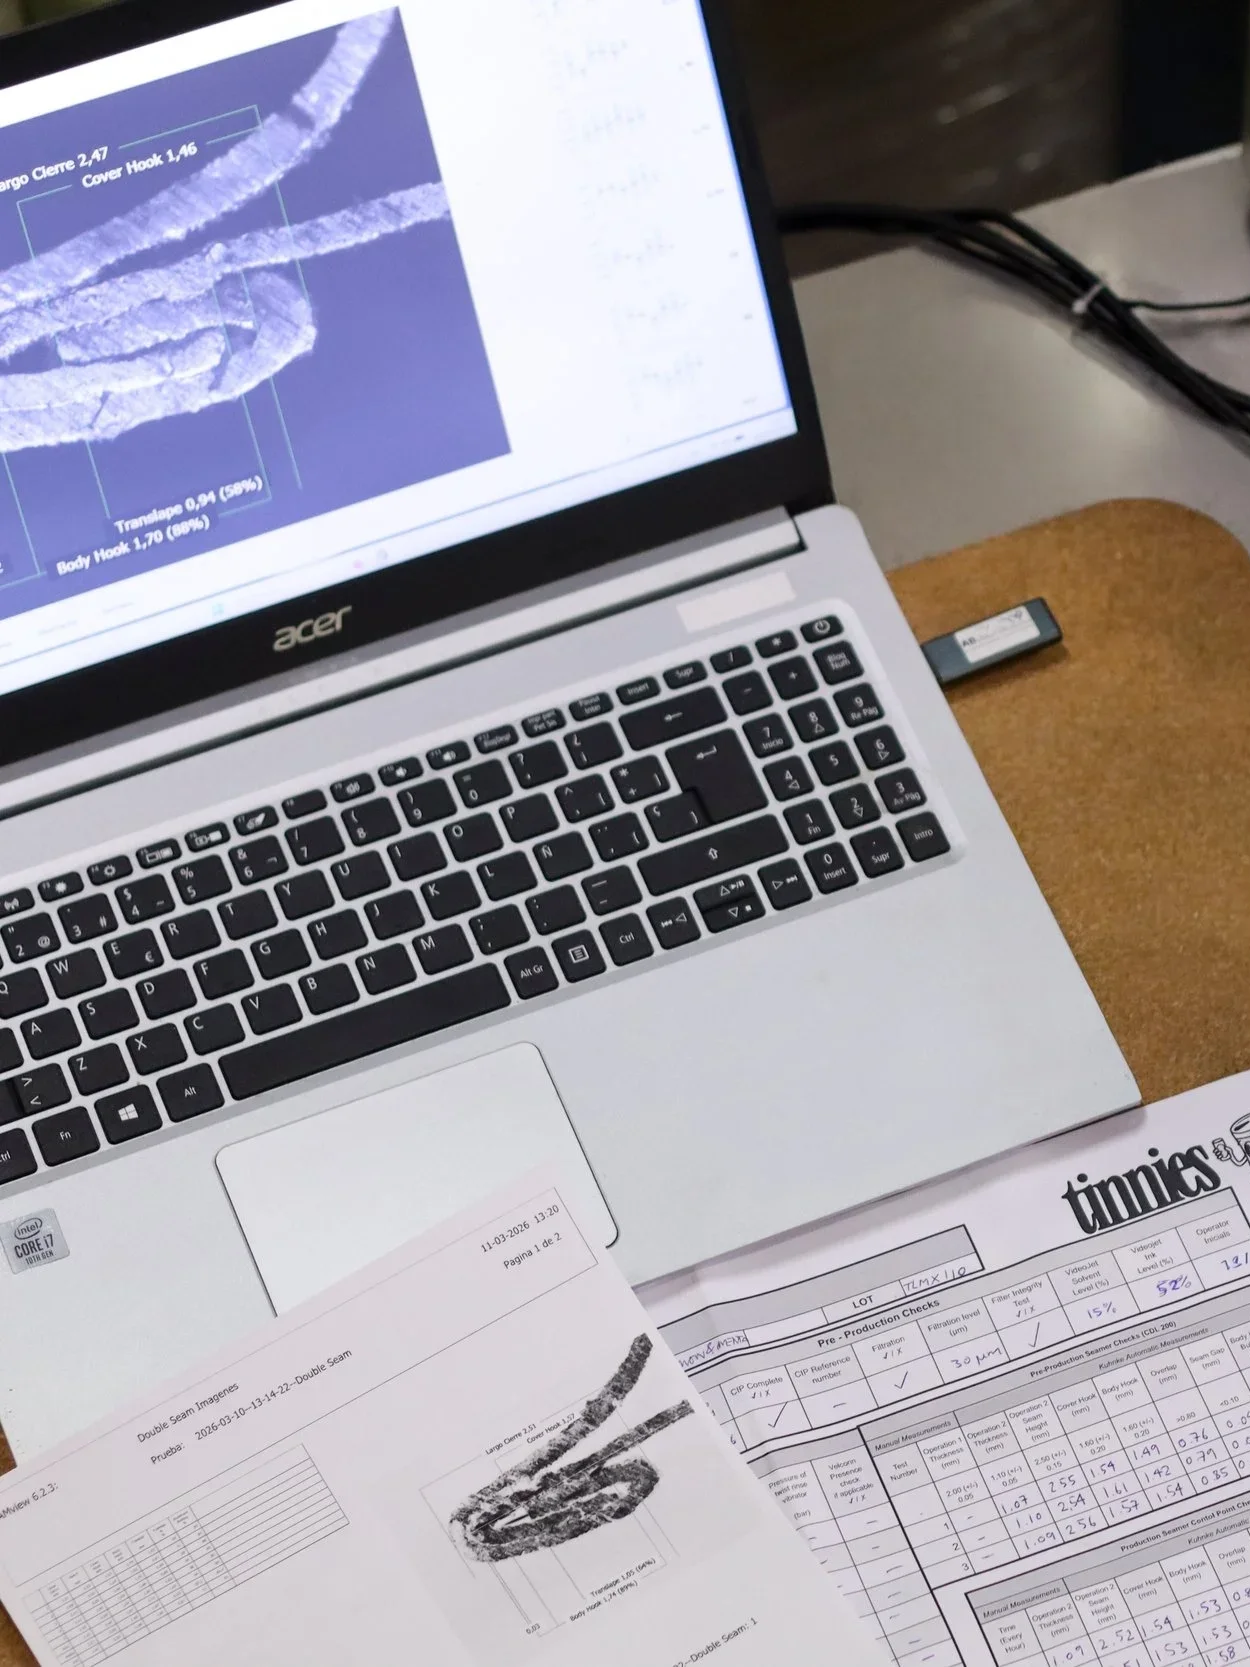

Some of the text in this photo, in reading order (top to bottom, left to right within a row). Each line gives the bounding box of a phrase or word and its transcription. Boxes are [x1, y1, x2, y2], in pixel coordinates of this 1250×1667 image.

[32, 159, 76, 180] Cierre
[78, 145, 109, 168] 2,47
[82, 141, 198, 188] Cover Hook 1,46
[114, 503, 183, 534] Translape
[185, 490, 215, 510] 0,94
[57, 554, 90, 576] Body
[93, 541, 130, 564] Hook
[133, 530, 163, 551] 1,70
[273, 604, 352, 652] acer
[627, 684, 649, 696] Insert
[763, 737, 783, 750] Inicio
[829, 755, 839, 766] 5
[808, 825, 821, 836] Fin
[914, 828, 933, 840] Intro
[871, 851, 890, 864] Supr
[824, 868, 846, 880] Insert
[429, 884, 439, 897] K
[168, 923, 179, 936] R
[421, 936, 436, 950] M
[620, 932, 634, 944] Ctrl
[259, 941, 271, 955] G
[54, 960, 69, 975] W
[520, 964, 544, 978] Alt Gr
[306, 977, 317, 990] B
[30, 1022, 42, 1035] A
[184, 1086, 196, 1097] Alt
[60, 1130, 71, 1141] Fn
[1062, 1145, 1221, 1234] tinnies
[17, 1222, 39, 1236] intel
[481, 1204, 559, 1253] 11-03-2026 13:20
[1196, 1219, 1229, 1237] Operator
[15, 1234, 54, 1258] CORE i7
[504, 1232, 562, 1269] Pagina 1 de 2
[26, 1250, 54, 1265] 10TH GEN
[1145, 1251, 1156, 1261] Ink
[1072, 1271, 1101, 1285] Solvent
[1072, 1284, 1093, 1296] Level
[852, 1295, 874, 1309] LOT
[1088, 1301, 1117, 1321] 15%
[818, 1299, 940, 1348] Pre Production Checks
[928, 1308, 981, 1332] Filtration level
[1030, 1348, 1084, 1378] Pre-Production
[1086, 1340, 1111, 1358] Seamer
[1113, 1332, 1140, 1347] Checks
[1099, 1327, 1209, 1370] Kuhnke Automatic Measurements
[1209, 1347, 1225, 1359] Gap
[951, 1357, 971, 1369] 30
[1150, 1364, 1177, 1378] Overlap
[730, 1376, 784, 1396] CIP Complete
[138, 1383, 239, 1443] Double Seam Imagenes
[150, 1442, 185, 1464] Prueba:
[327, 1349, 352, 1368] Seam
[1057, 1401, 1078, 1412] Cover
[527, 1413, 576, 1445] Cover Hook 1,57
[875, 1421, 951, 1451] Manual Measurements
[485, 1423, 537, 1456] Largo Cierre 2,51
[891, 1468, 918, 1482] Number
[32, 1483, 58, 1501] 6.2.3:
[794, 1508, 811, 1520] (bar)
[1121, 1533, 1161, 1552] Production
[1217, 1501, 1235, 1513] Point
[590, 1577, 620, 1598] Translape
[570, 1609, 586, 1622] Body
[586, 1601, 602, 1613] Hook
[1032, 1602, 1073, 1623] Operation 2
[722, 1622, 750, 1643] Seam:
[750, 1617, 758, 1626] 1
[999, 1624, 1016, 1634] Time
